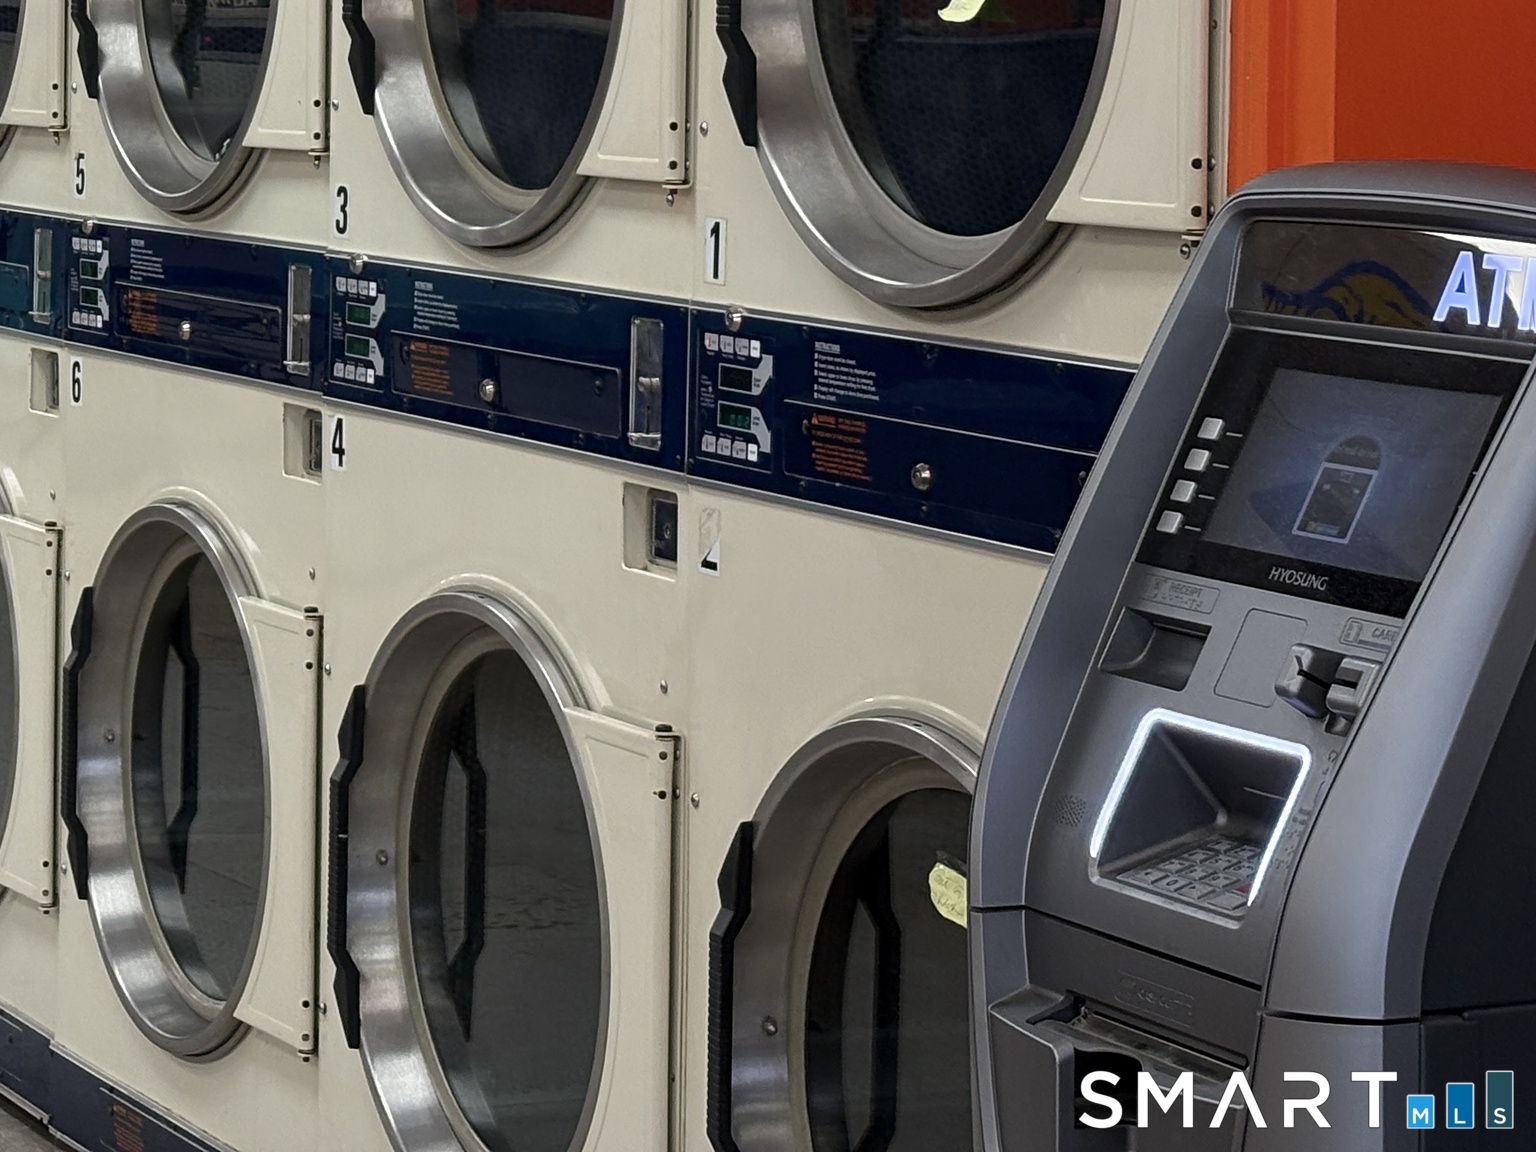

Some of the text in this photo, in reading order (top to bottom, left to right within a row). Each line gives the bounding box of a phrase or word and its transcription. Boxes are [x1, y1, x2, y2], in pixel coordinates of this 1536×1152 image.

[75, 152, 85, 196] 5
[335, 186, 349, 235] 3
[709, 221, 721, 280] 1
[71, 360, 82, 404] 6
[332, 418, 346, 468] 4
[1168, 580, 1203, 596] RECEIPT
[1268, 566, 1329, 591] HYOSUNG
